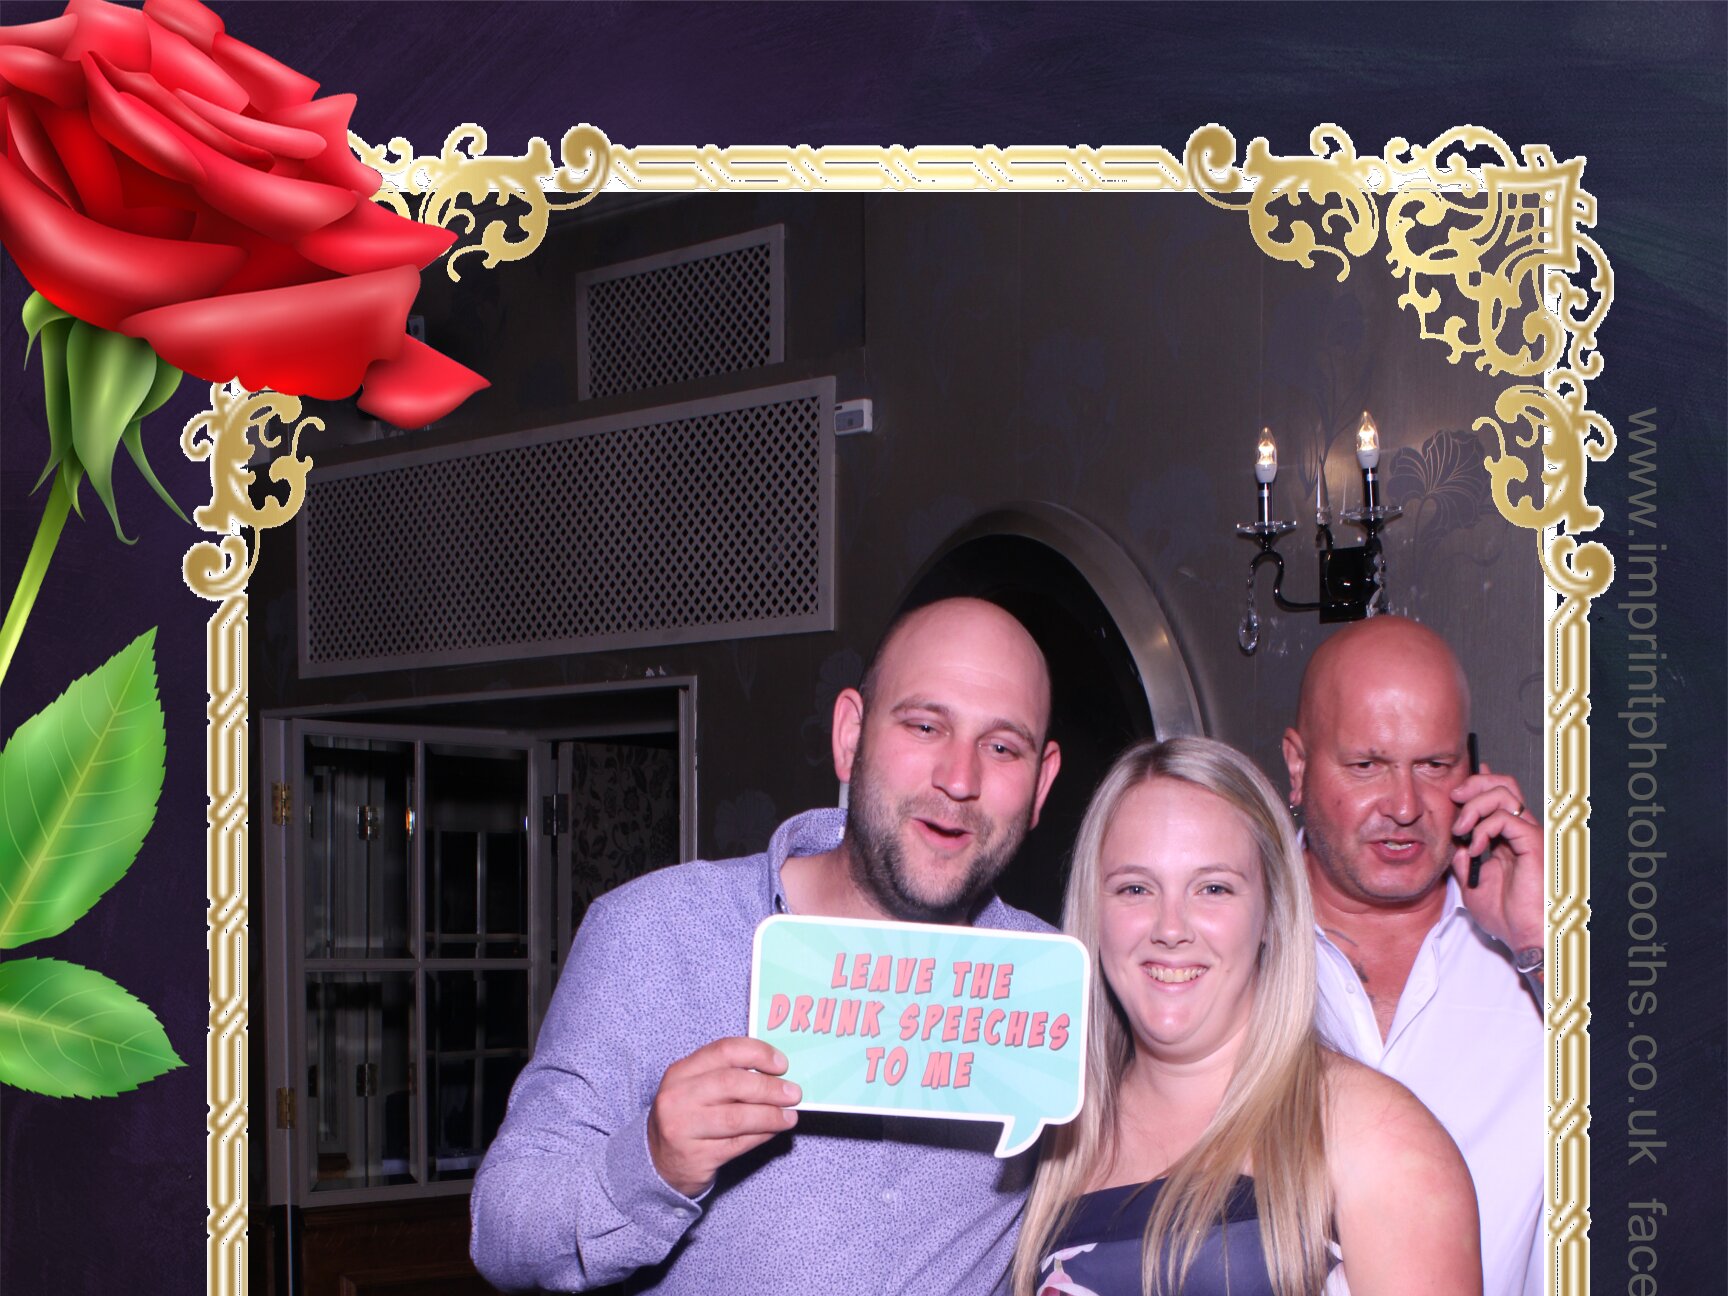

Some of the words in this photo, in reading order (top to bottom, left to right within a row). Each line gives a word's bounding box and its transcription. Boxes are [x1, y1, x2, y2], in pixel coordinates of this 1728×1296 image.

[831, 953, 936, 996] LEAVE
[953, 961, 1014, 1000] THE
[767, 993, 885, 1038] DRUNK
[899, 1003, 1070, 1051] SPEECHES
[865, 1046, 909, 1086] TO
[921, 1051, 975, 1090] ME
